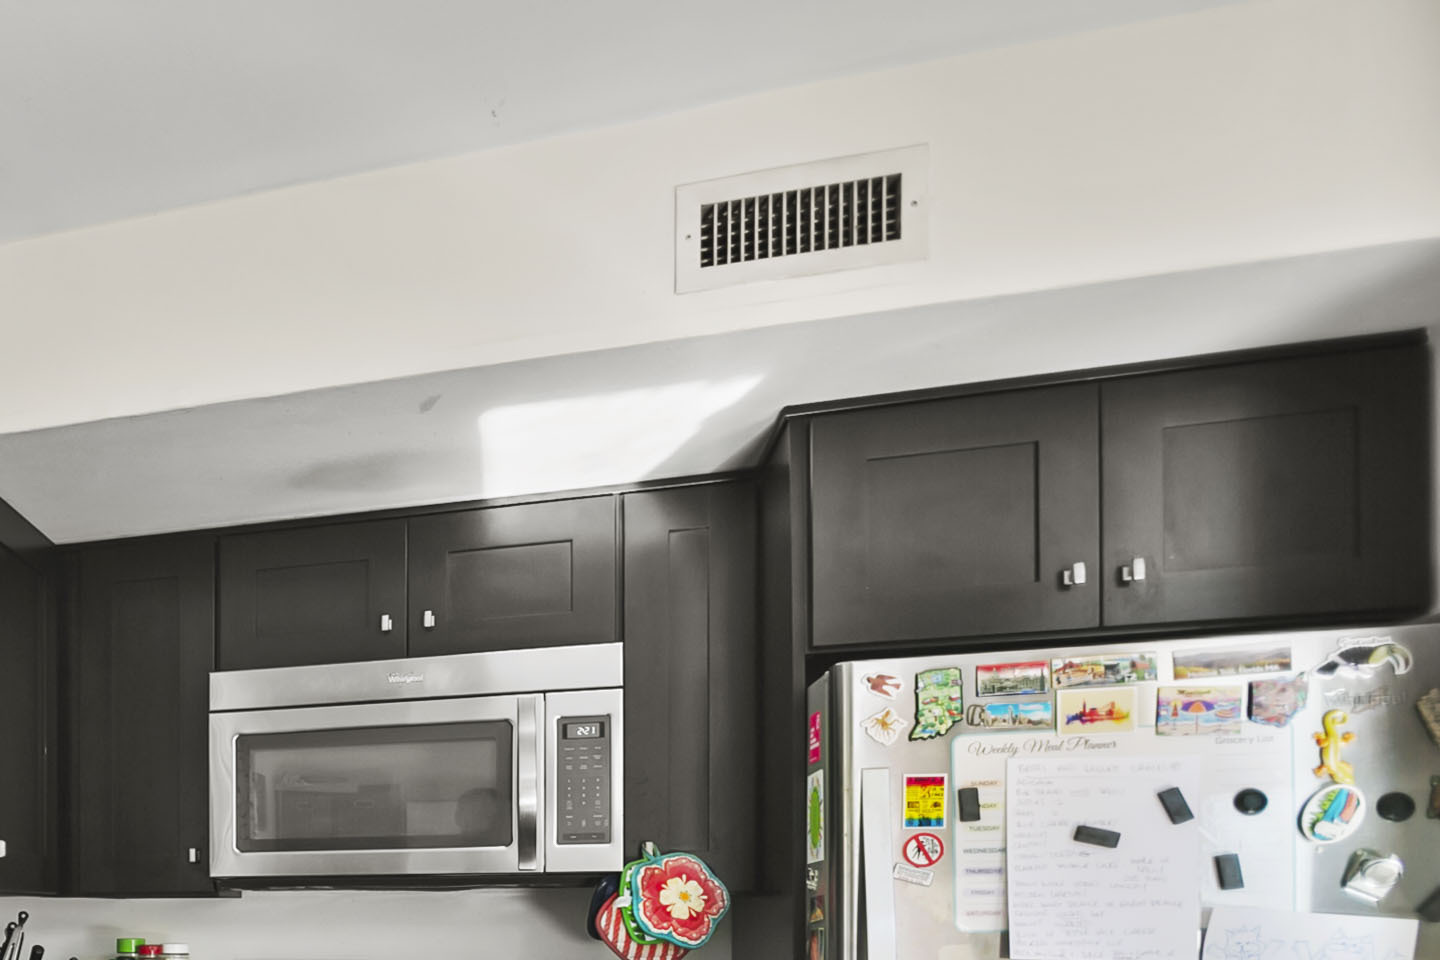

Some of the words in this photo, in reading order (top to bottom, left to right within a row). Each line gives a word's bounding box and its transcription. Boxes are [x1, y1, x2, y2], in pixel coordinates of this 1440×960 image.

[968, 741, 1019, 757] Weekly
[1023, 738, 1064, 753] Meal
[1066, 736, 1117, 751] Planner
